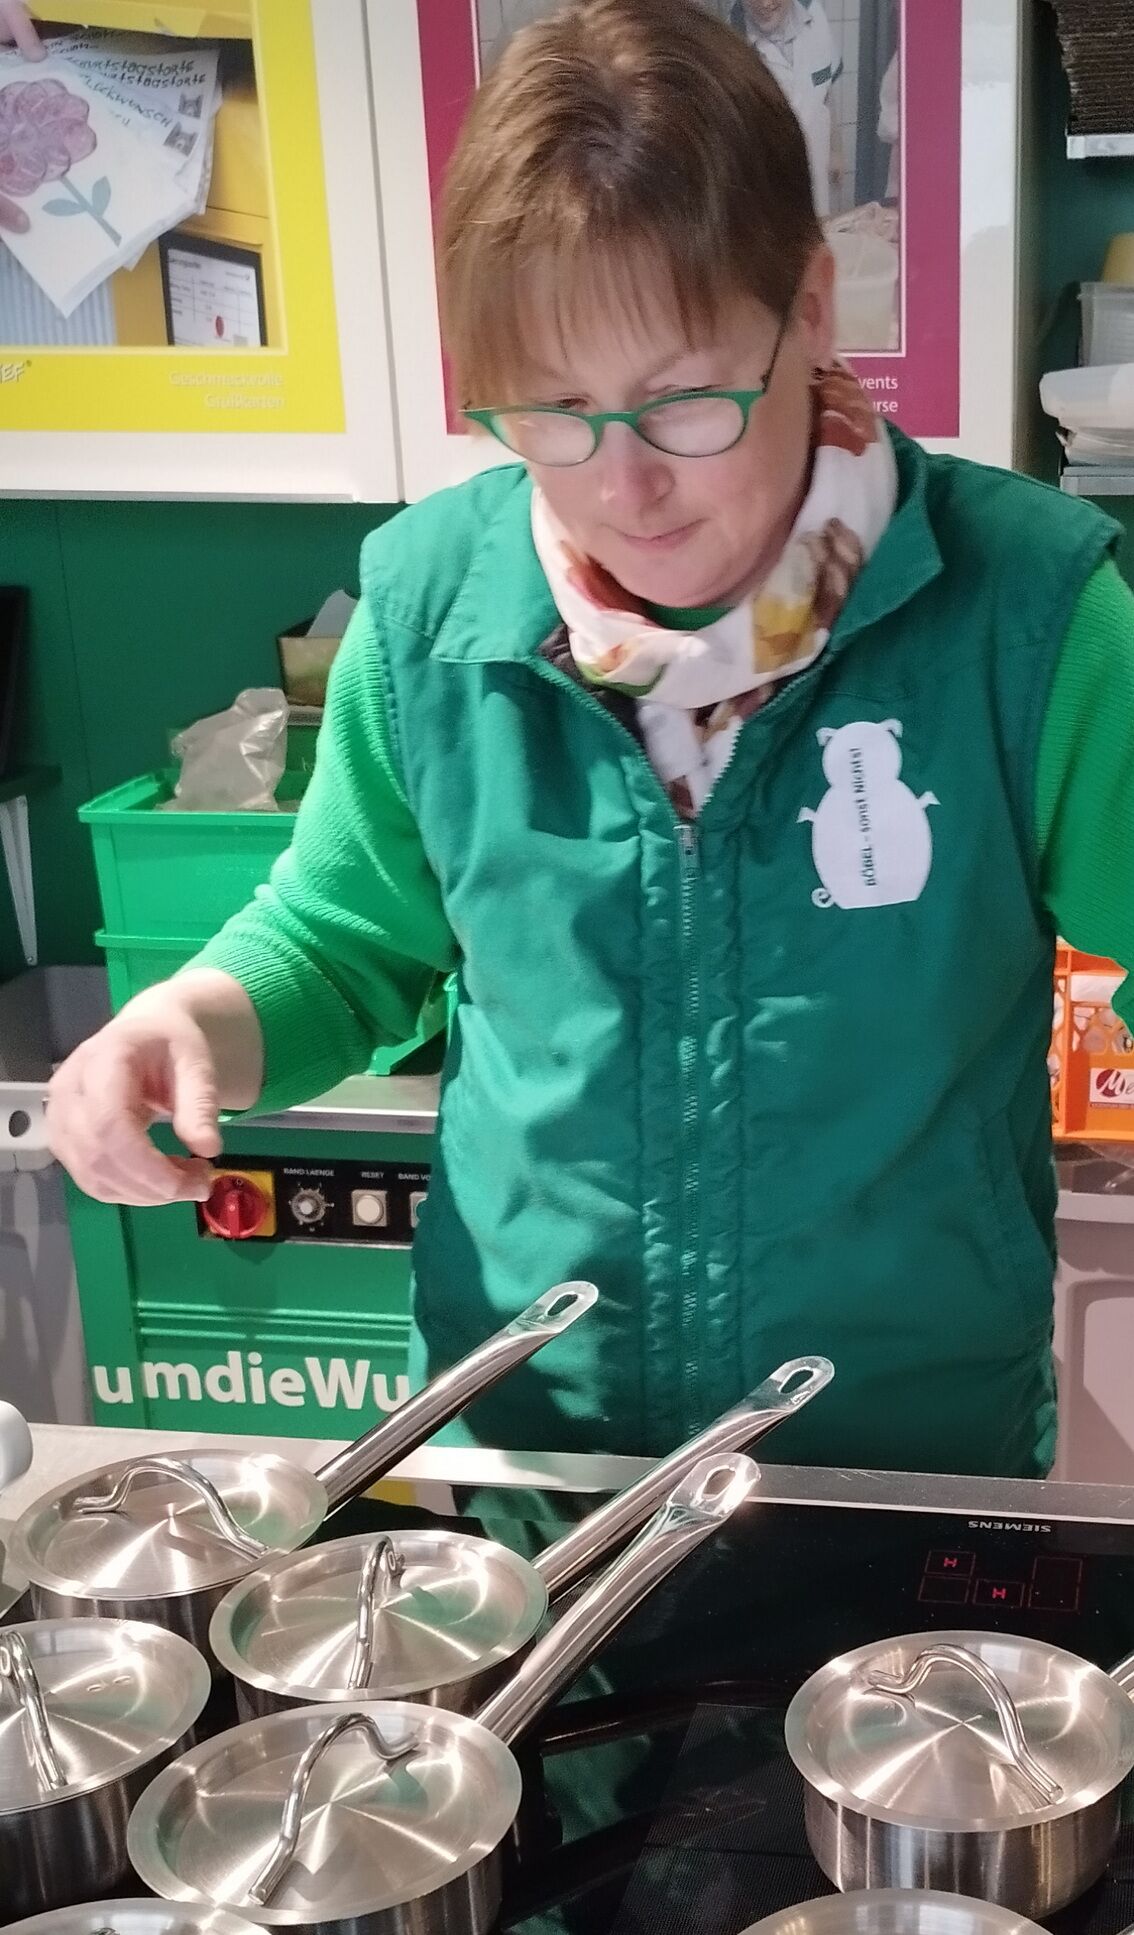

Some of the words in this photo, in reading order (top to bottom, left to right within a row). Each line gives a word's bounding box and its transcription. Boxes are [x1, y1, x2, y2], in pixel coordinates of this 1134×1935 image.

[856, 375, 899, 390] vents
[398, 1172, 419, 1181] BAND
[967, 1520, 1052, 1533] SIEMENS
